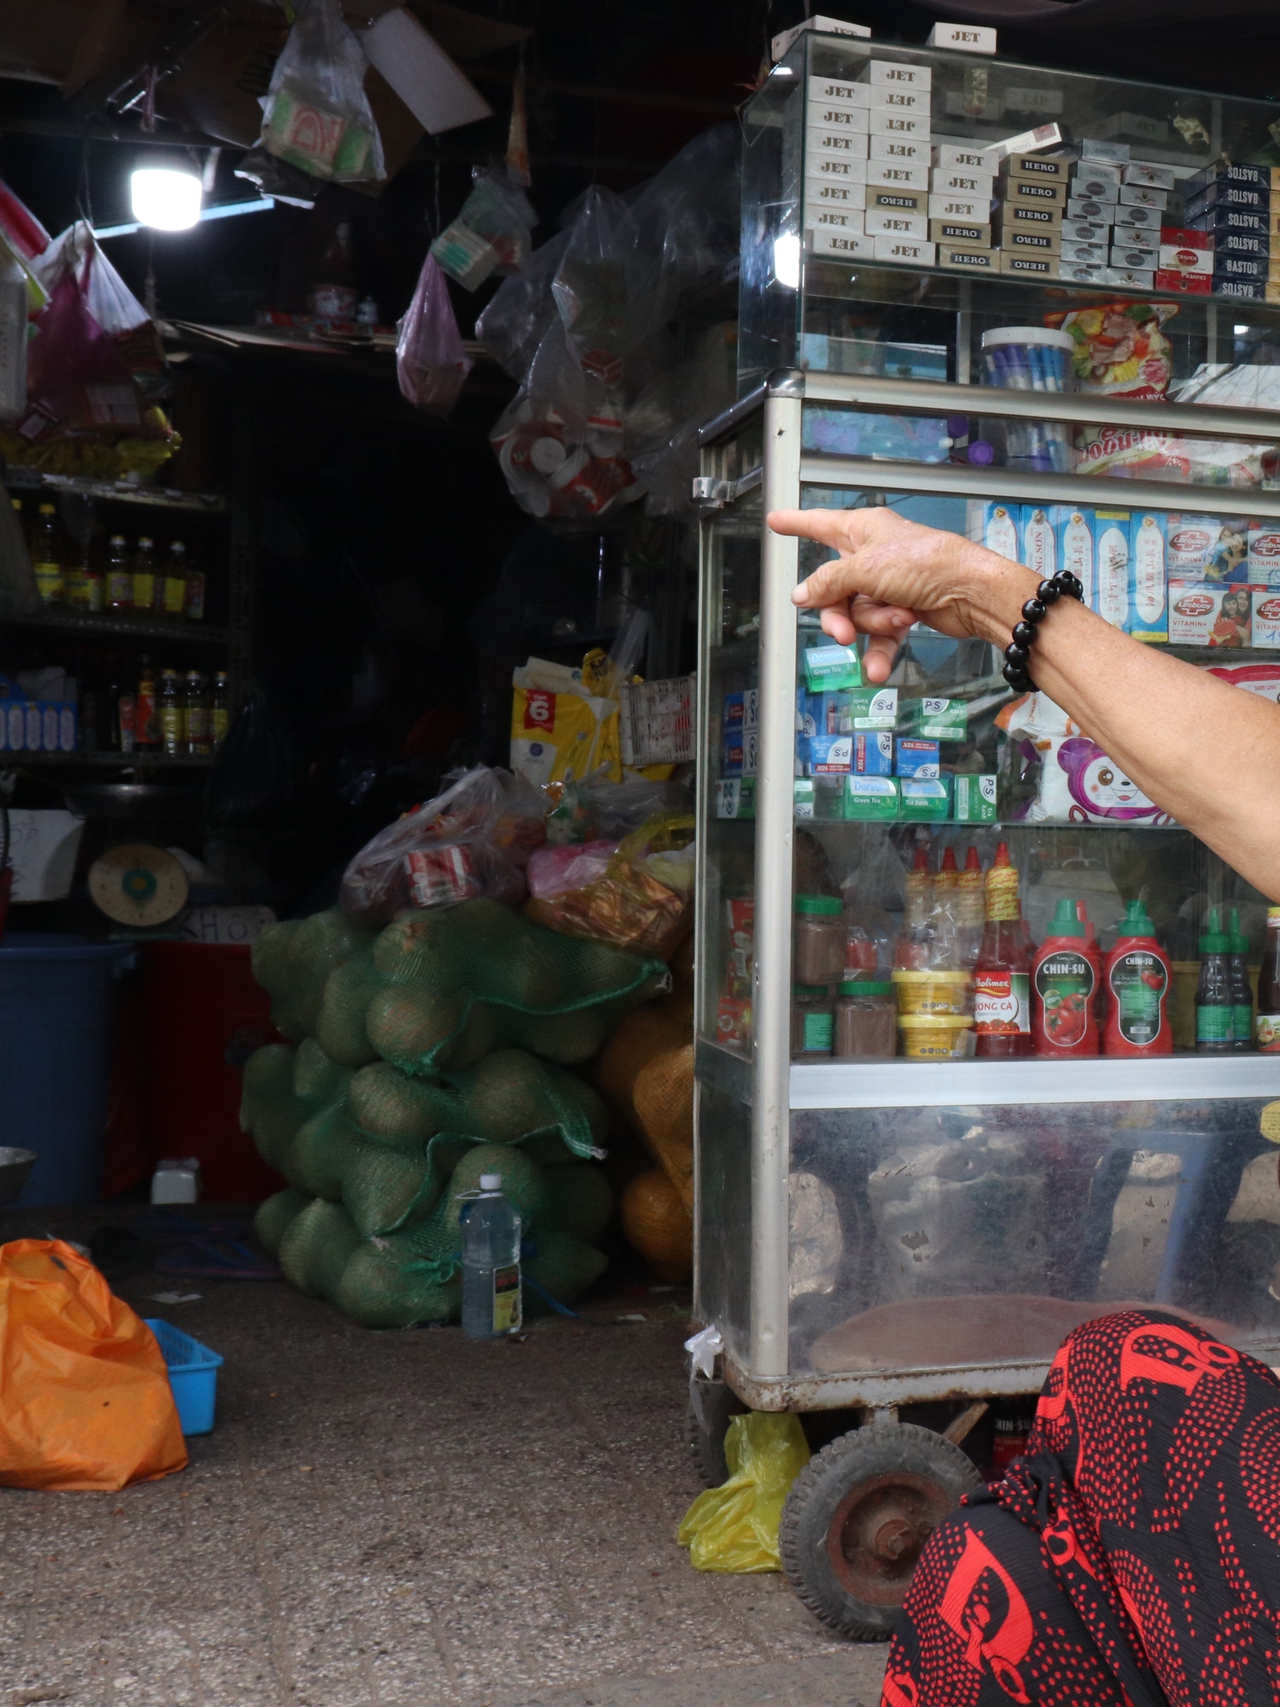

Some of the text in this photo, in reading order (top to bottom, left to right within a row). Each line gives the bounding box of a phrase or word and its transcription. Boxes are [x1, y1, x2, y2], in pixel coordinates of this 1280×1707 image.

[951, 31, 981, 42] JET
[886, 69, 916, 82] JET
[825, 85, 855, 98] JET
[886, 94, 916, 107] JET
[823, 111, 853, 124] JET
[886, 119, 916, 131] JET
[822, 136, 853, 149] JET
[887, 144, 916, 157] JET
[956, 154, 984, 166] JET
[821, 162, 851, 174] JET
[1025, 162, 1055, 172] HERO
[883, 169, 912, 181] JET
[1228, 166, 1259, 182] BASTOS
[949, 177, 978, 190] JET
[820, 187, 850, 199] JET
[1022, 187, 1053, 197] HERO
[1228, 189, 1259, 204] BASTOS
[880, 197, 913, 207] HERO
[945, 203, 974, 215] JET
[819, 214, 848, 226] JET
[1018, 210, 1049, 221] HERO
[1228, 213, 1259, 229] BASTOS
[883, 219, 912, 231] JET
[946, 228, 978, 238] HERO
[830, 238, 858, 251] JET
[1016, 235, 1047, 246] HERO
[1228, 236, 1259, 251] BASTOS
[891, 245, 920, 258] JET
[954, 254, 986, 265] HERO
[1014, 261, 1046, 271] HERO
[1227, 259, 1258, 274] BASTOS
[1223, 282, 1254, 297] BASTOS
[1174, 536, 1207, 547] Lifebuoy
[1178, 600, 1212, 611] Lifebuoy
[811, 651, 845, 663] Doreen
[529, 701, 549, 721] 6
[1125, 957, 1154, 966] CHIN-SU
[1043, 964, 1085, 975] CHIN-SU
[1001, 1002, 1013, 1011] CÀ
